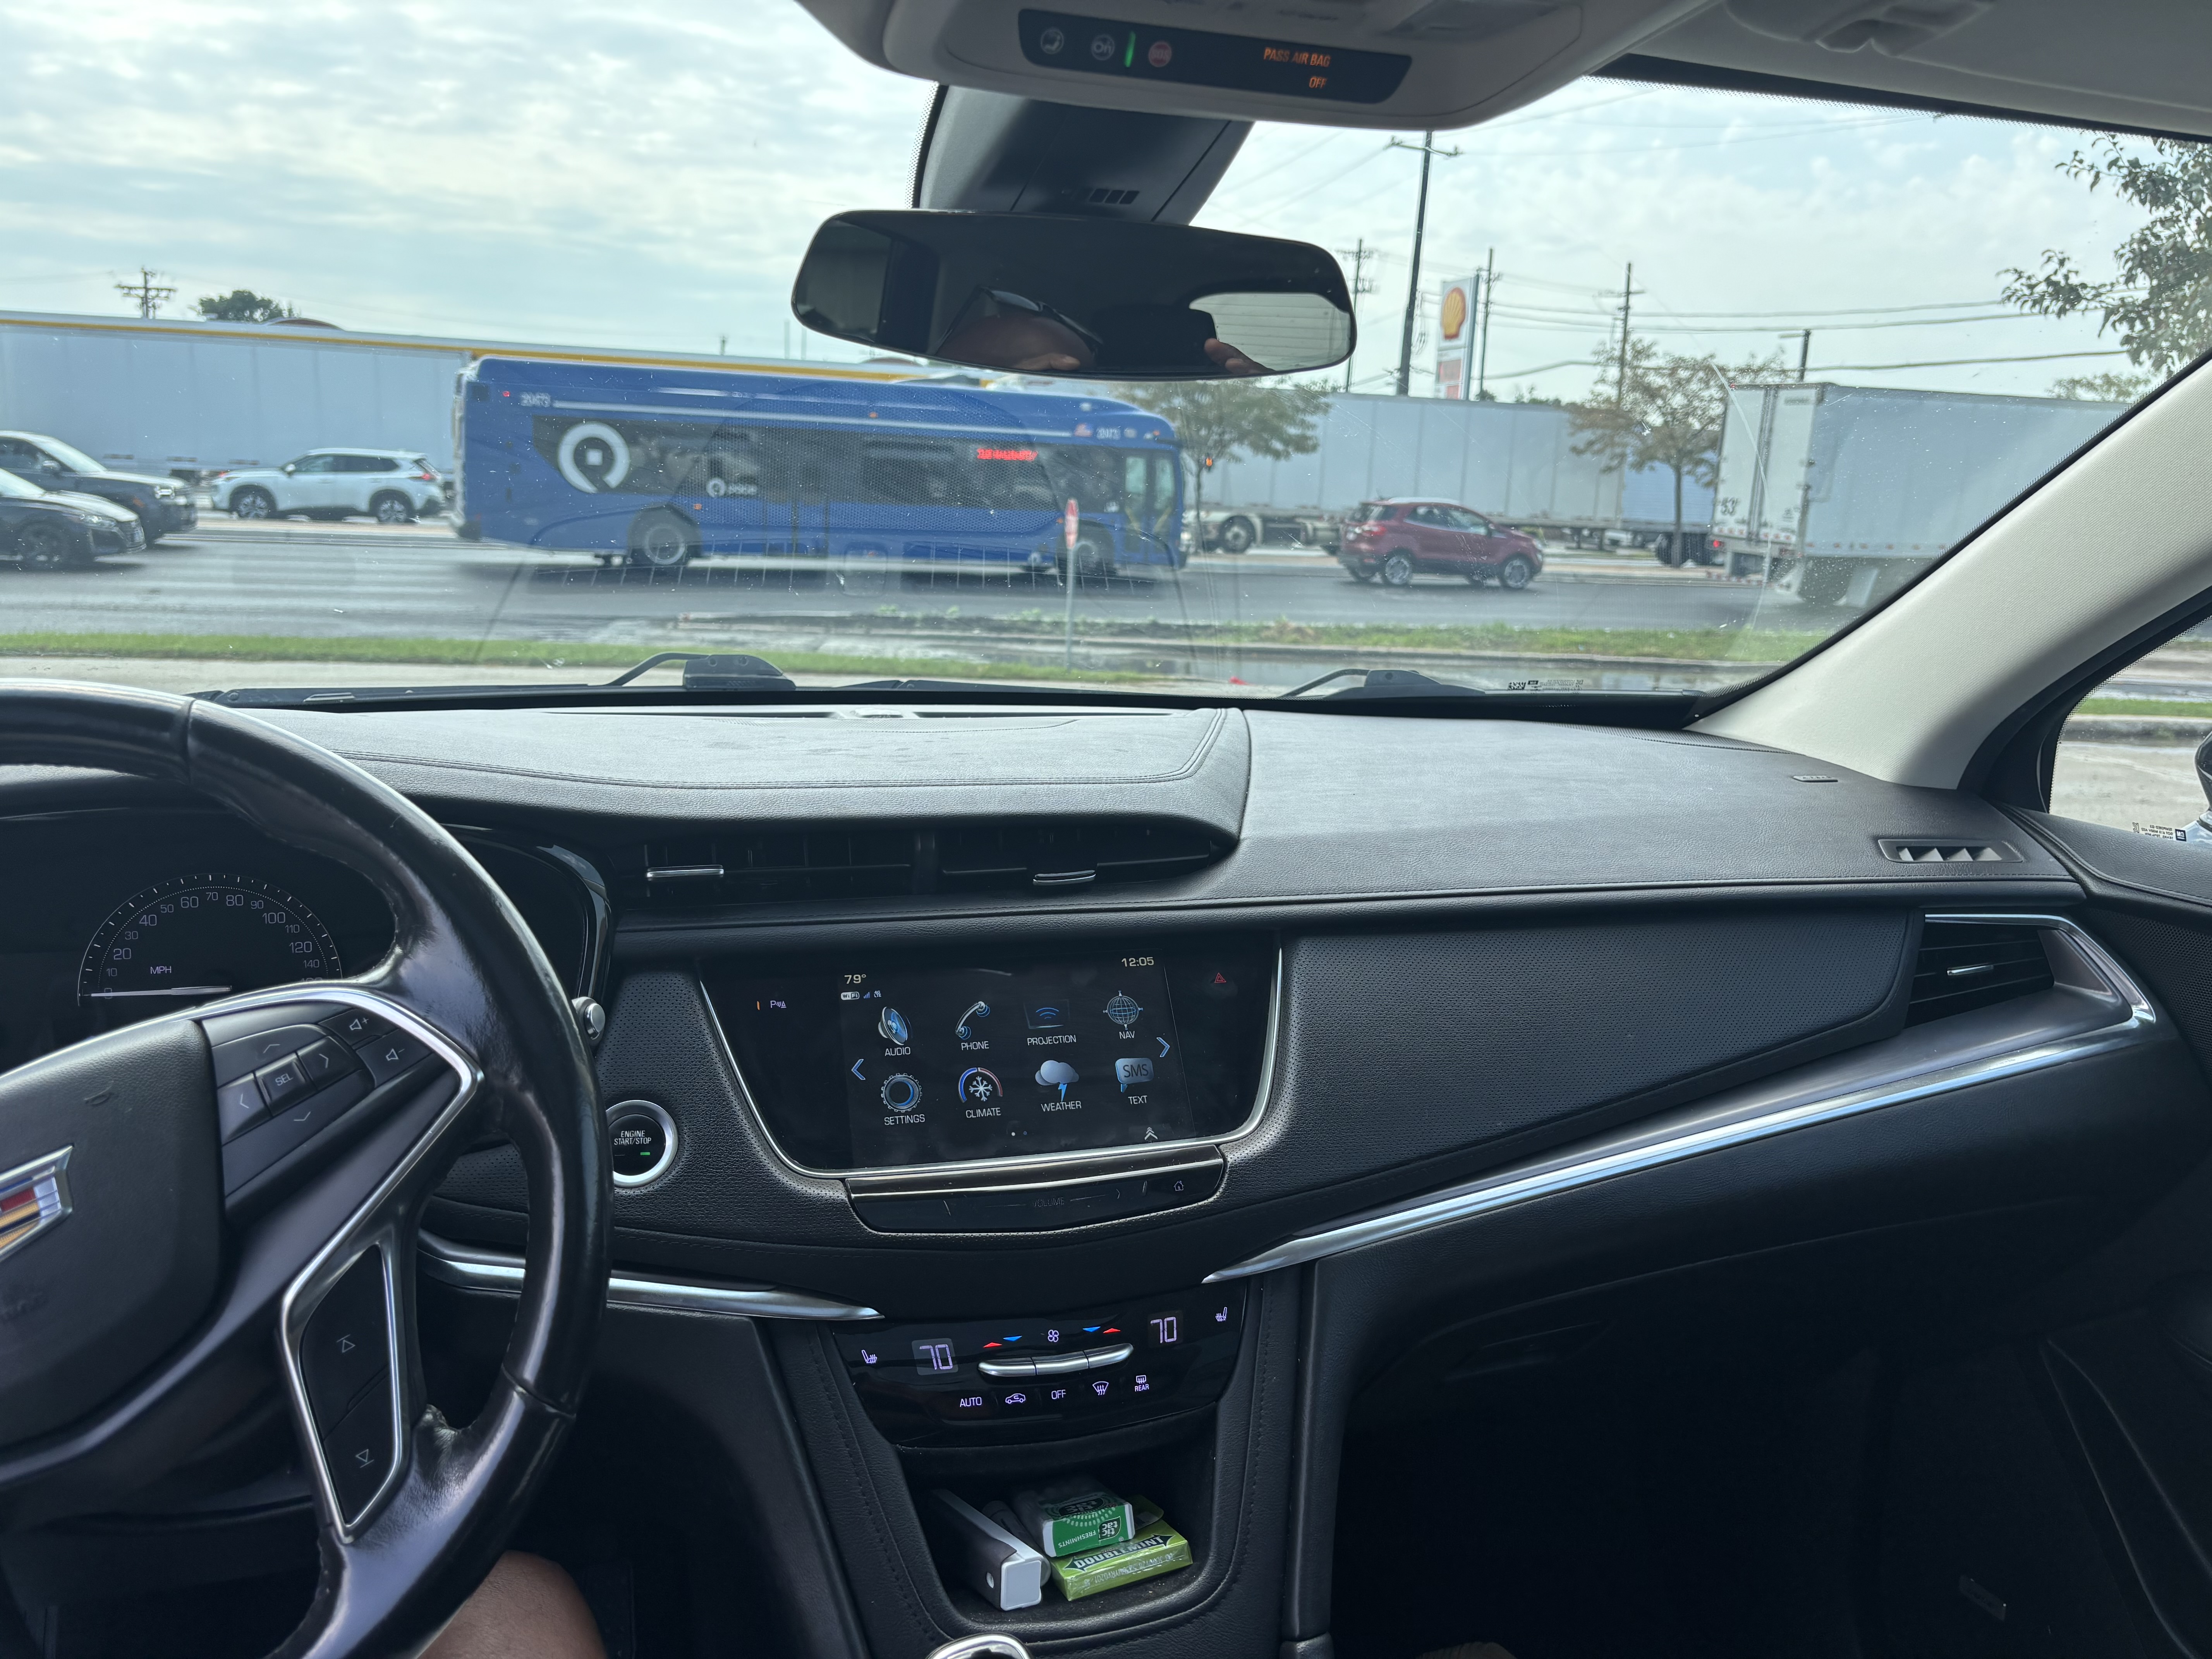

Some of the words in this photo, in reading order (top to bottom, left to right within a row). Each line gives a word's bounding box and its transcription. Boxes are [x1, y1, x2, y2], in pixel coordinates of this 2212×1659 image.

[1264, 47, 1290, 62] PASS
[1291, 52, 1309, 65] AIR
[1310, 53, 1331, 67] BAG
[1309, 76, 1327, 88] OFF
[205, 892, 218, 901] 70
[226, 895, 244, 906] 80
[180, 896, 199, 908] 60
[251, 900, 264, 909] 90
[160, 904, 174, 913] 50
[139, 914, 157, 927] 40
[262, 912, 285, 924] 100
[285, 924, 300, 933] 110
[124, 931, 139, 940] 30
[289, 941, 312, 953] 120
[113, 948, 132, 960] 20
[303, 959, 320, 968] 140
[1121, 957, 1154, 967] 12:05
[106, 968, 117, 977] 10
[844, 974, 866, 984] 79°
[1119, 1031, 1135, 1039] NAV
[1027, 1035, 1076, 1046] PROJECTION
[884, 1046, 911, 1056] AUDIO
[961, 1041, 989, 1051] PHONE
[1123, 1064, 1149, 1078] SMS
[275, 1073, 294, 1086] SEL
[1128, 1096, 1147, 1104] TEXT
[1041, 1101, 1082, 1112] WEATHER
[965, 1107, 1001, 1118] CLIMATE
[884, 1114, 925, 1125] SETTINGS
[614, 1137, 651, 1145] START/STOP
[1034, 1197, 1065, 1207] VOLUME
[1151, 1317, 1177, 1343] 70
[919, 1344, 953, 1370] 70
[1134, 1384, 1149, 1392] REAR
[1051, 1389, 1066, 1400] OFF
[960, 1397, 982, 1407] AUTO
[1101, 1520, 1118, 1530] tac
[1101, 1527, 1116, 1537] tic
[1058, 1530, 1097, 1548] FRESHMINTS
[1073, 1536, 1164, 1568] DOUBLEMINT
